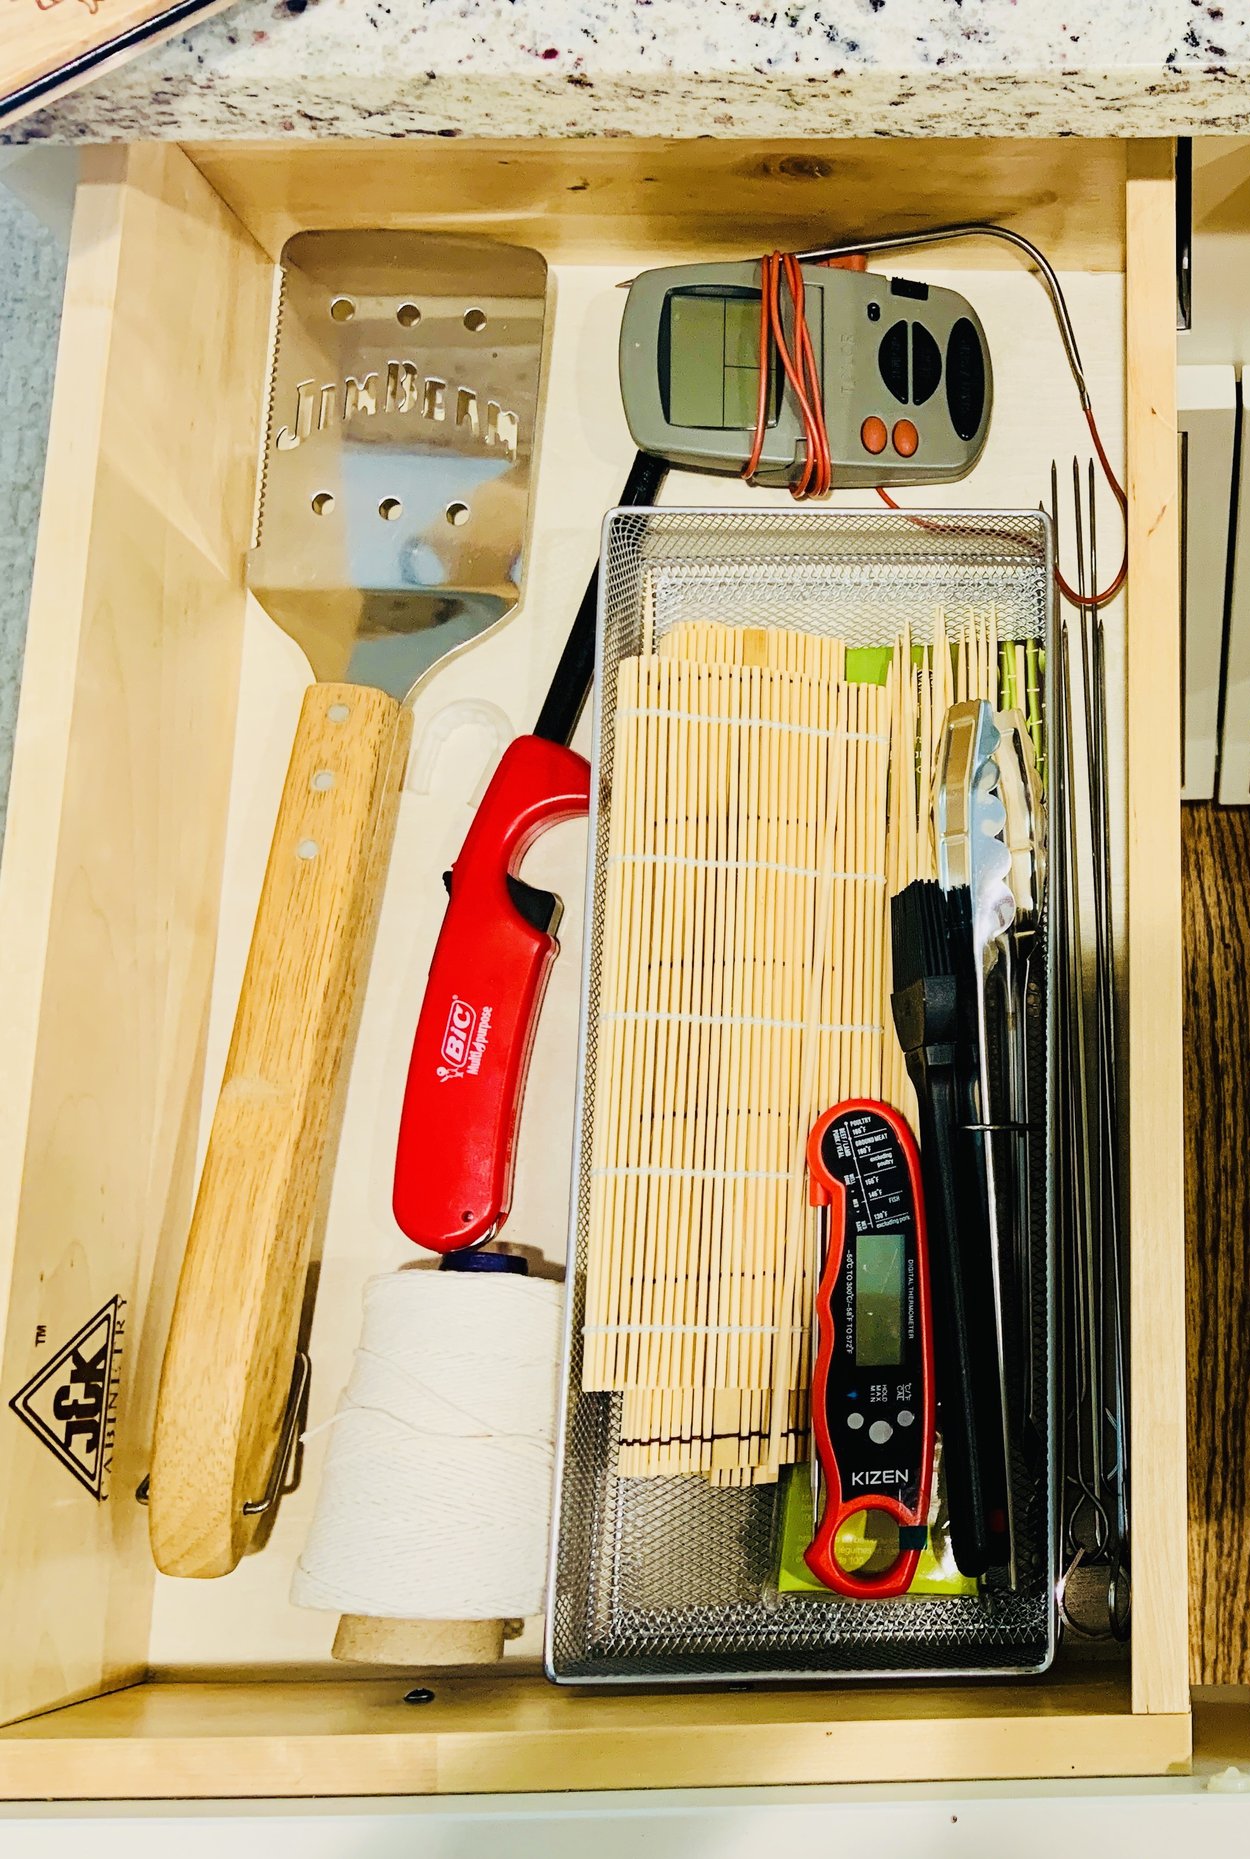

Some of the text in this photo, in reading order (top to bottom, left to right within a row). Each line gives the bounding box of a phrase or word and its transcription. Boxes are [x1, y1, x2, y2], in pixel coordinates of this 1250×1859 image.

[384, 359, 519, 462] BEAM
[445, 1003, 471, 1063] BIC
[850, 1116, 872, 1128] POULTRY
[855, 1133, 888, 1148] GROUND MEAT
[869, 1151, 893, 1163] excluding
[876, 1158, 894, 1169] poultry
[889, 1195, 901, 1204] FISH
[876, 1217, 900, 1229] excluding
[846, 1270, 854, 1281] TO
[846, 1323, 854, 1334] TO
[35, 1325, 47, 1347] TM
[896, 1384, 904, 1401] CAL
[851, 1469, 909, 1486] KIZEN
